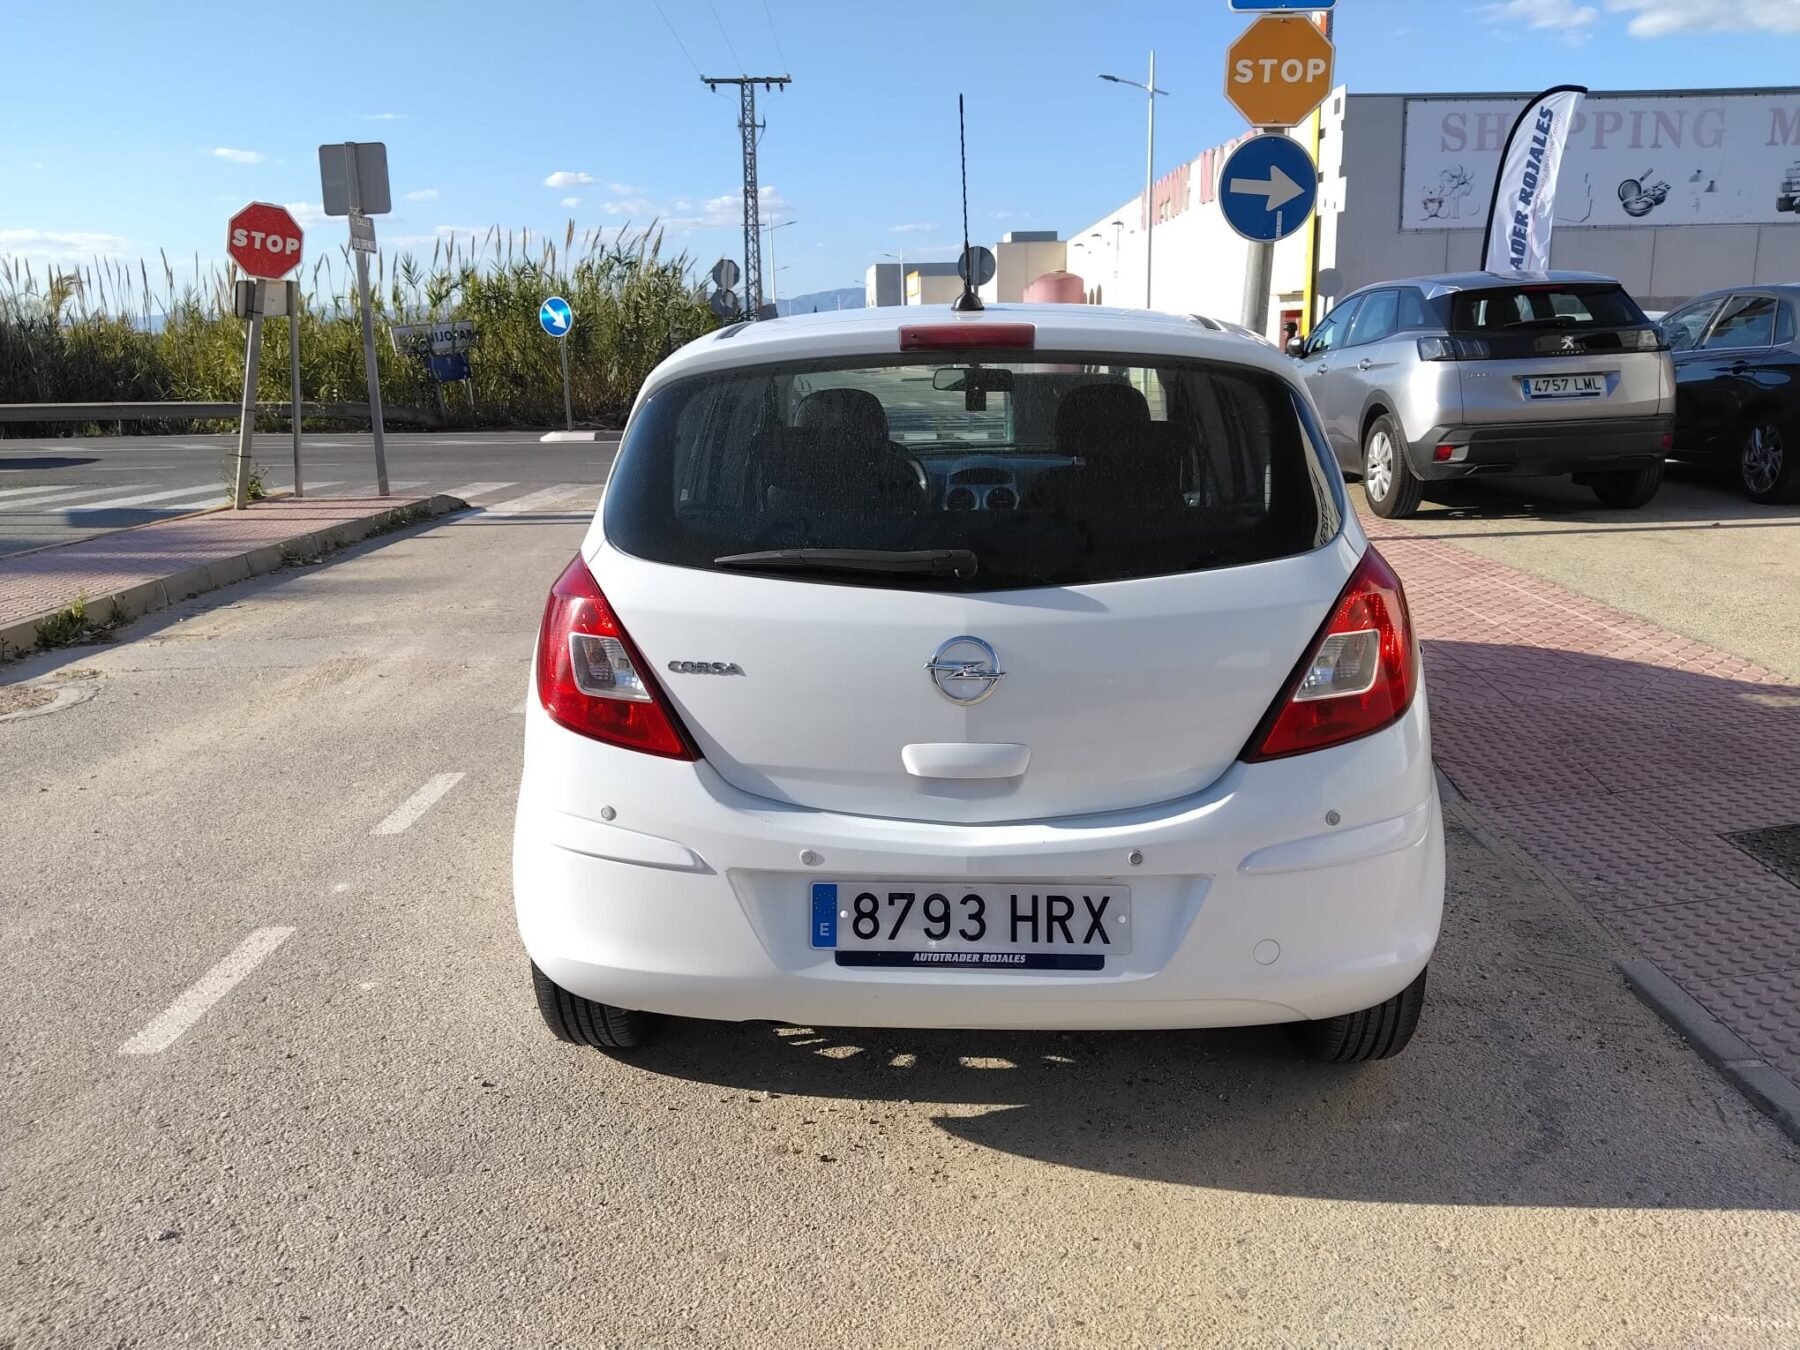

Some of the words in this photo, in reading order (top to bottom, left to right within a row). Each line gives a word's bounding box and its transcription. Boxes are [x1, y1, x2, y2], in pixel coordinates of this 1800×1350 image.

[1234, 58, 1326, 84] STOP
[1441, 107, 1728, 153] SHPPING
[1518, 105, 1554, 206] ROJALES
[232, 228, 300, 255] STOP
[1534, 379, 1569, 393] 4757
[1574, 377, 1602, 391] LML
[668, 660, 747, 677] CORSA
[819, 922, 830, 937] E
[852, 892, 987, 942] 8793
[1010, 894, 1111, 945] HRX
[912, 952, 980, 963] AUTOTRADER
[982, 953, 1027, 964] ROJALES
